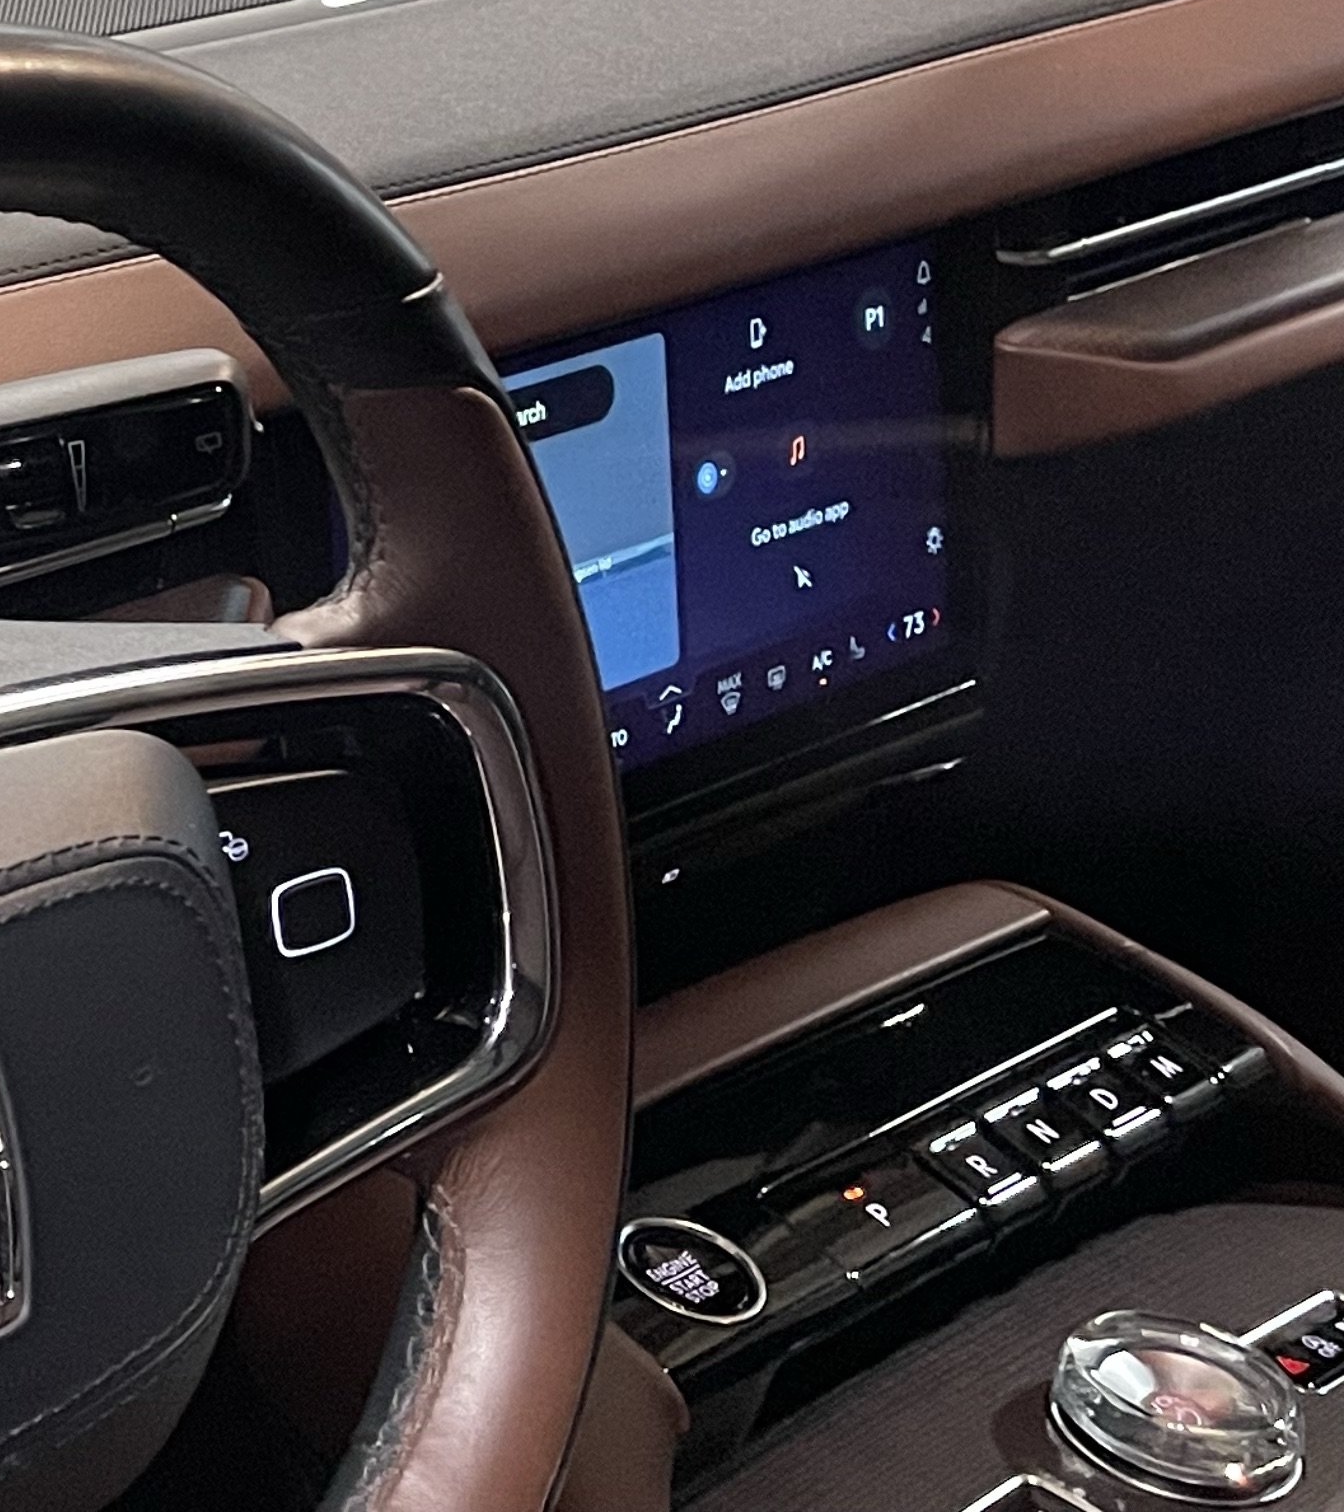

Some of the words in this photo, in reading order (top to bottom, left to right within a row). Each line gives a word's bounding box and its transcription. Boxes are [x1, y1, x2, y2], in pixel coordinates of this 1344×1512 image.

[865, 305, 885, 331] P1
[724, 368, 752, 395] Add
[753, 359, 794, 390] phone
[751, 526, 772, 547] Go
[772, 523, 787, 540] to
[788, 508, 823, 535] audio
[825, 501, 849, 523] app
[903, 610, 925, 639] 73
[812, 649, 833, 672] A/C
[717, 672, 742, 695] MAX
[1089, 1088, 1119, 1110] D
[965, 1154, 999, 1178] R
[865, 1203, 890, 1227] P
[645, 1250, 698, 1283] ENGINE
[669, 1269, 711, 1296] START
[684, 1280, 721, 1305] STOP
